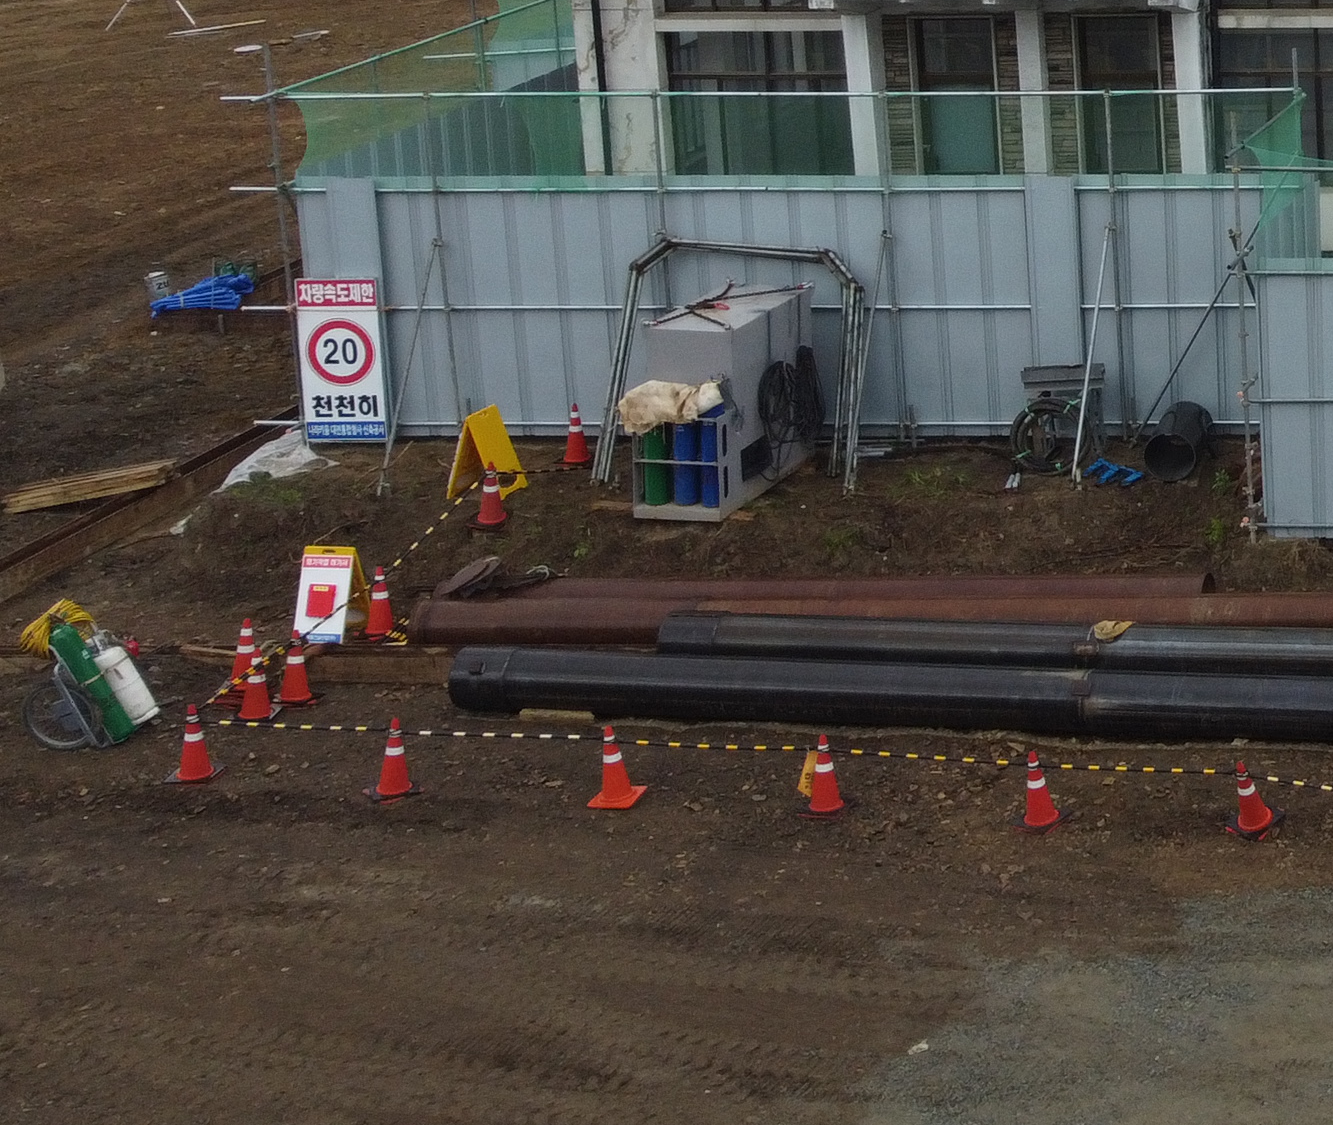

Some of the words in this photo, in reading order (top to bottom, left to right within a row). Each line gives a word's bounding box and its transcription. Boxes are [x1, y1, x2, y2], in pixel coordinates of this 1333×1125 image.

[299, 283, 374, 303] 차량속도제한
[323, 338, 358, 365] 20
[312, 394, 379, 418] 천천히
